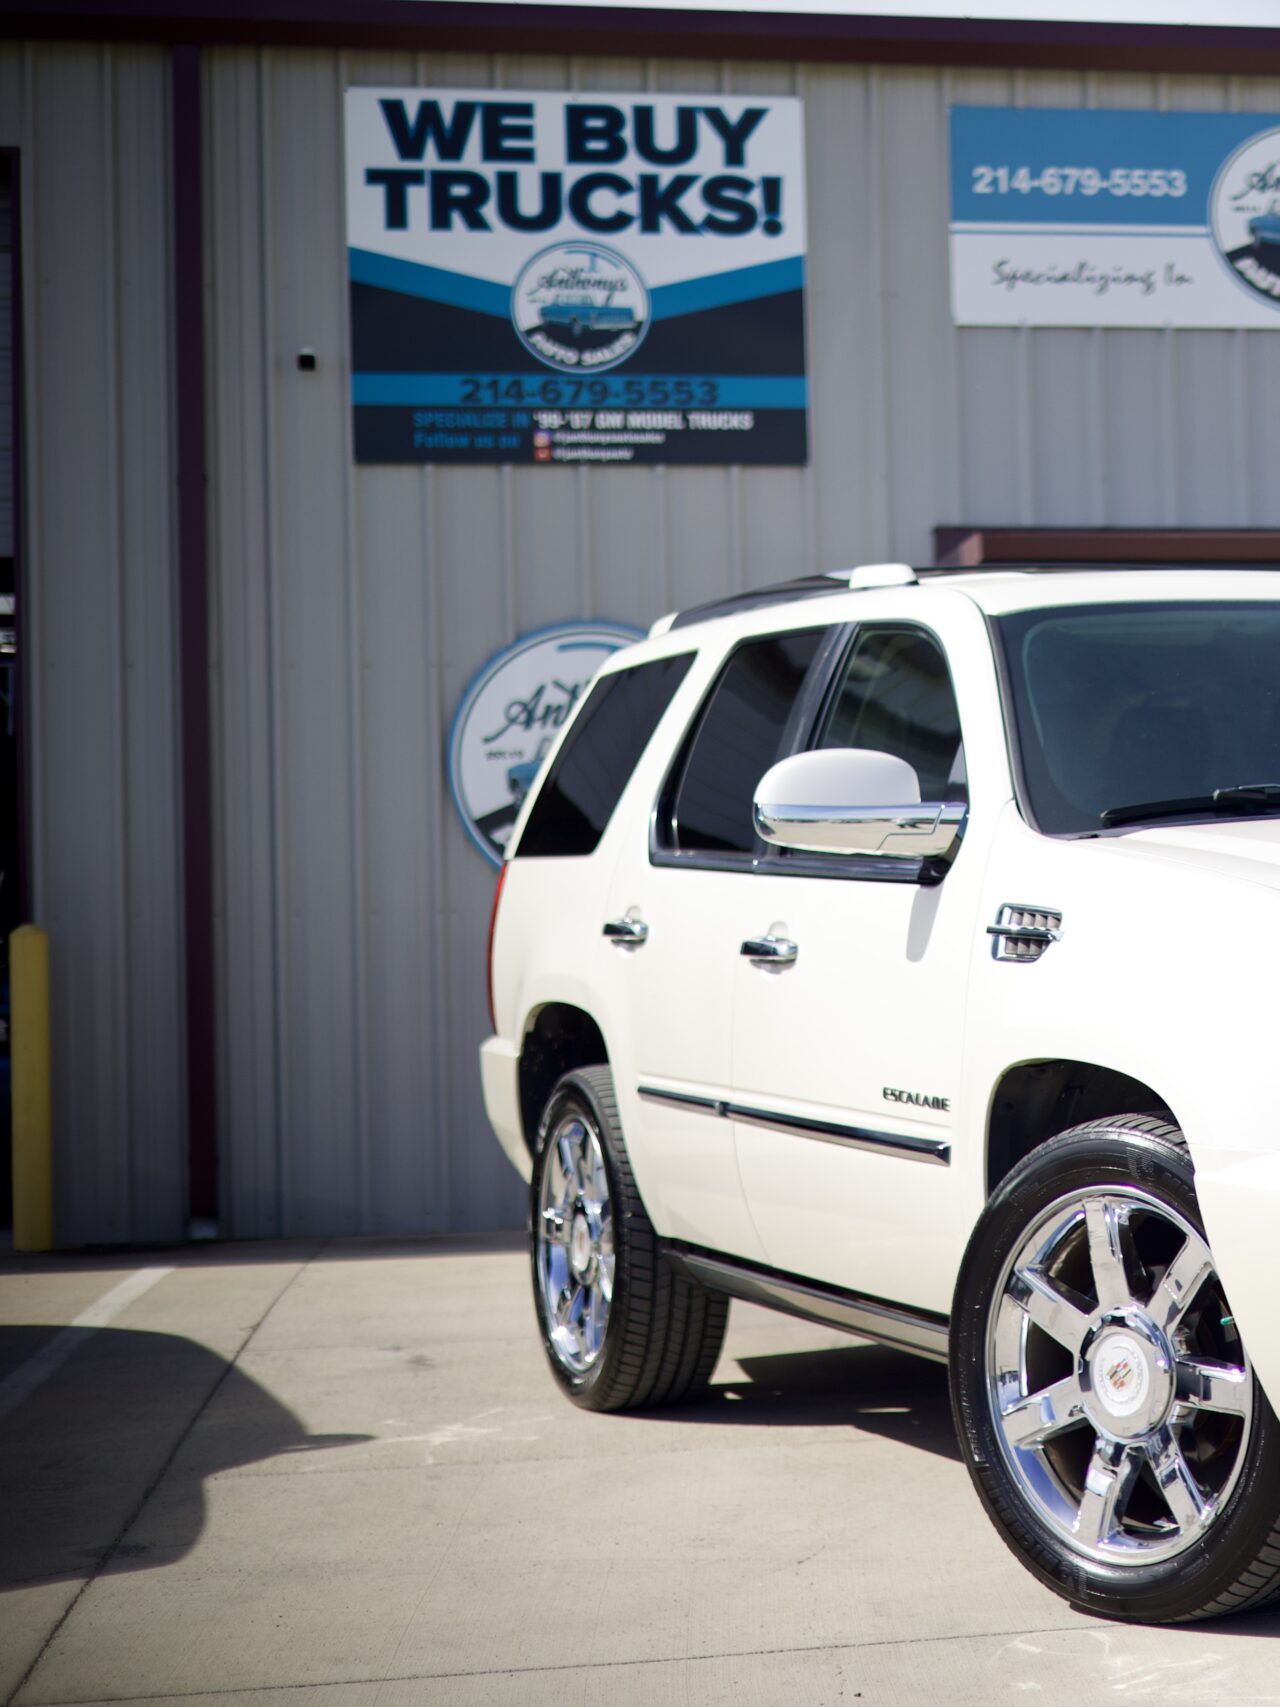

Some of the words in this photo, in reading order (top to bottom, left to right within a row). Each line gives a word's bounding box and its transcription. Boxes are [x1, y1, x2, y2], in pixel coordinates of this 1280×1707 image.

[377, 98, 536, 164] WE
[564, 102, 771, 168] BUY
[972, 166, 1188, 198] 214-679-5553
[365, 167, 784, 238] TRUCKS!
[991, 258, 1156, 295] Specializing
[1163, 262, 1194, 287] In
[459, 378, 720, 406] 214-679-5553
[687, 411, 755, 431] TRUCKS
[882, 1086, 951, 1112] ESCALADE
